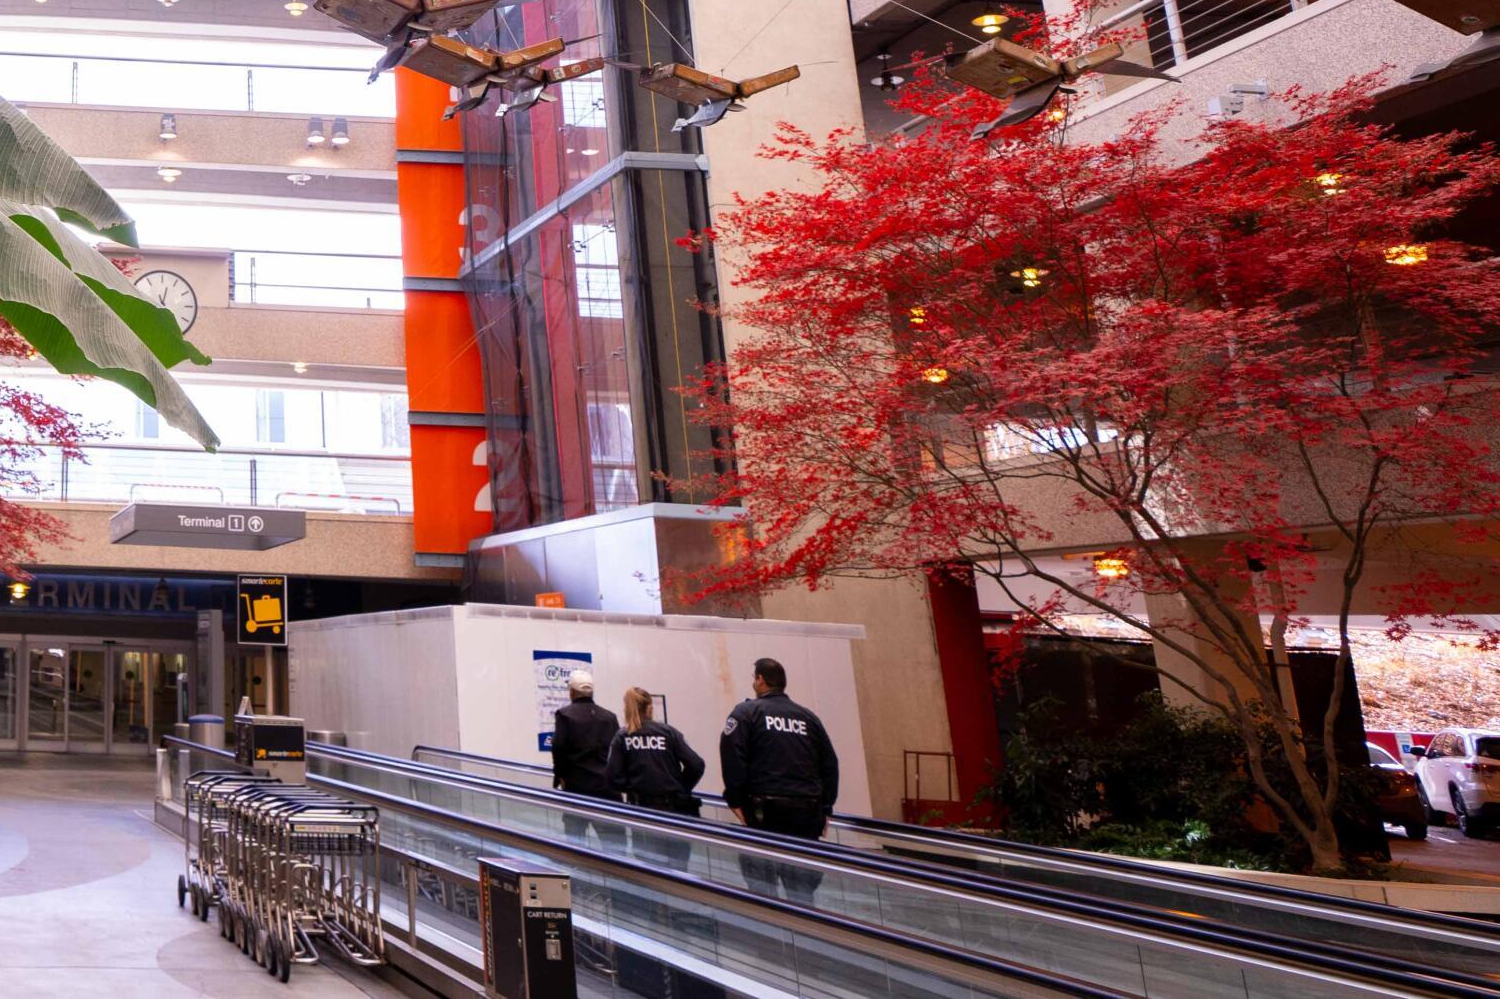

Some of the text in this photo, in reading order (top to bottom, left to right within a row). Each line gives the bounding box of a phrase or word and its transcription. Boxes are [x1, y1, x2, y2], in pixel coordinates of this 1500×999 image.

[177, 515, 225, 529] Terminal
[765, 715, 808, 736] POLICE
[625, 735, 667, 751] POLICE
